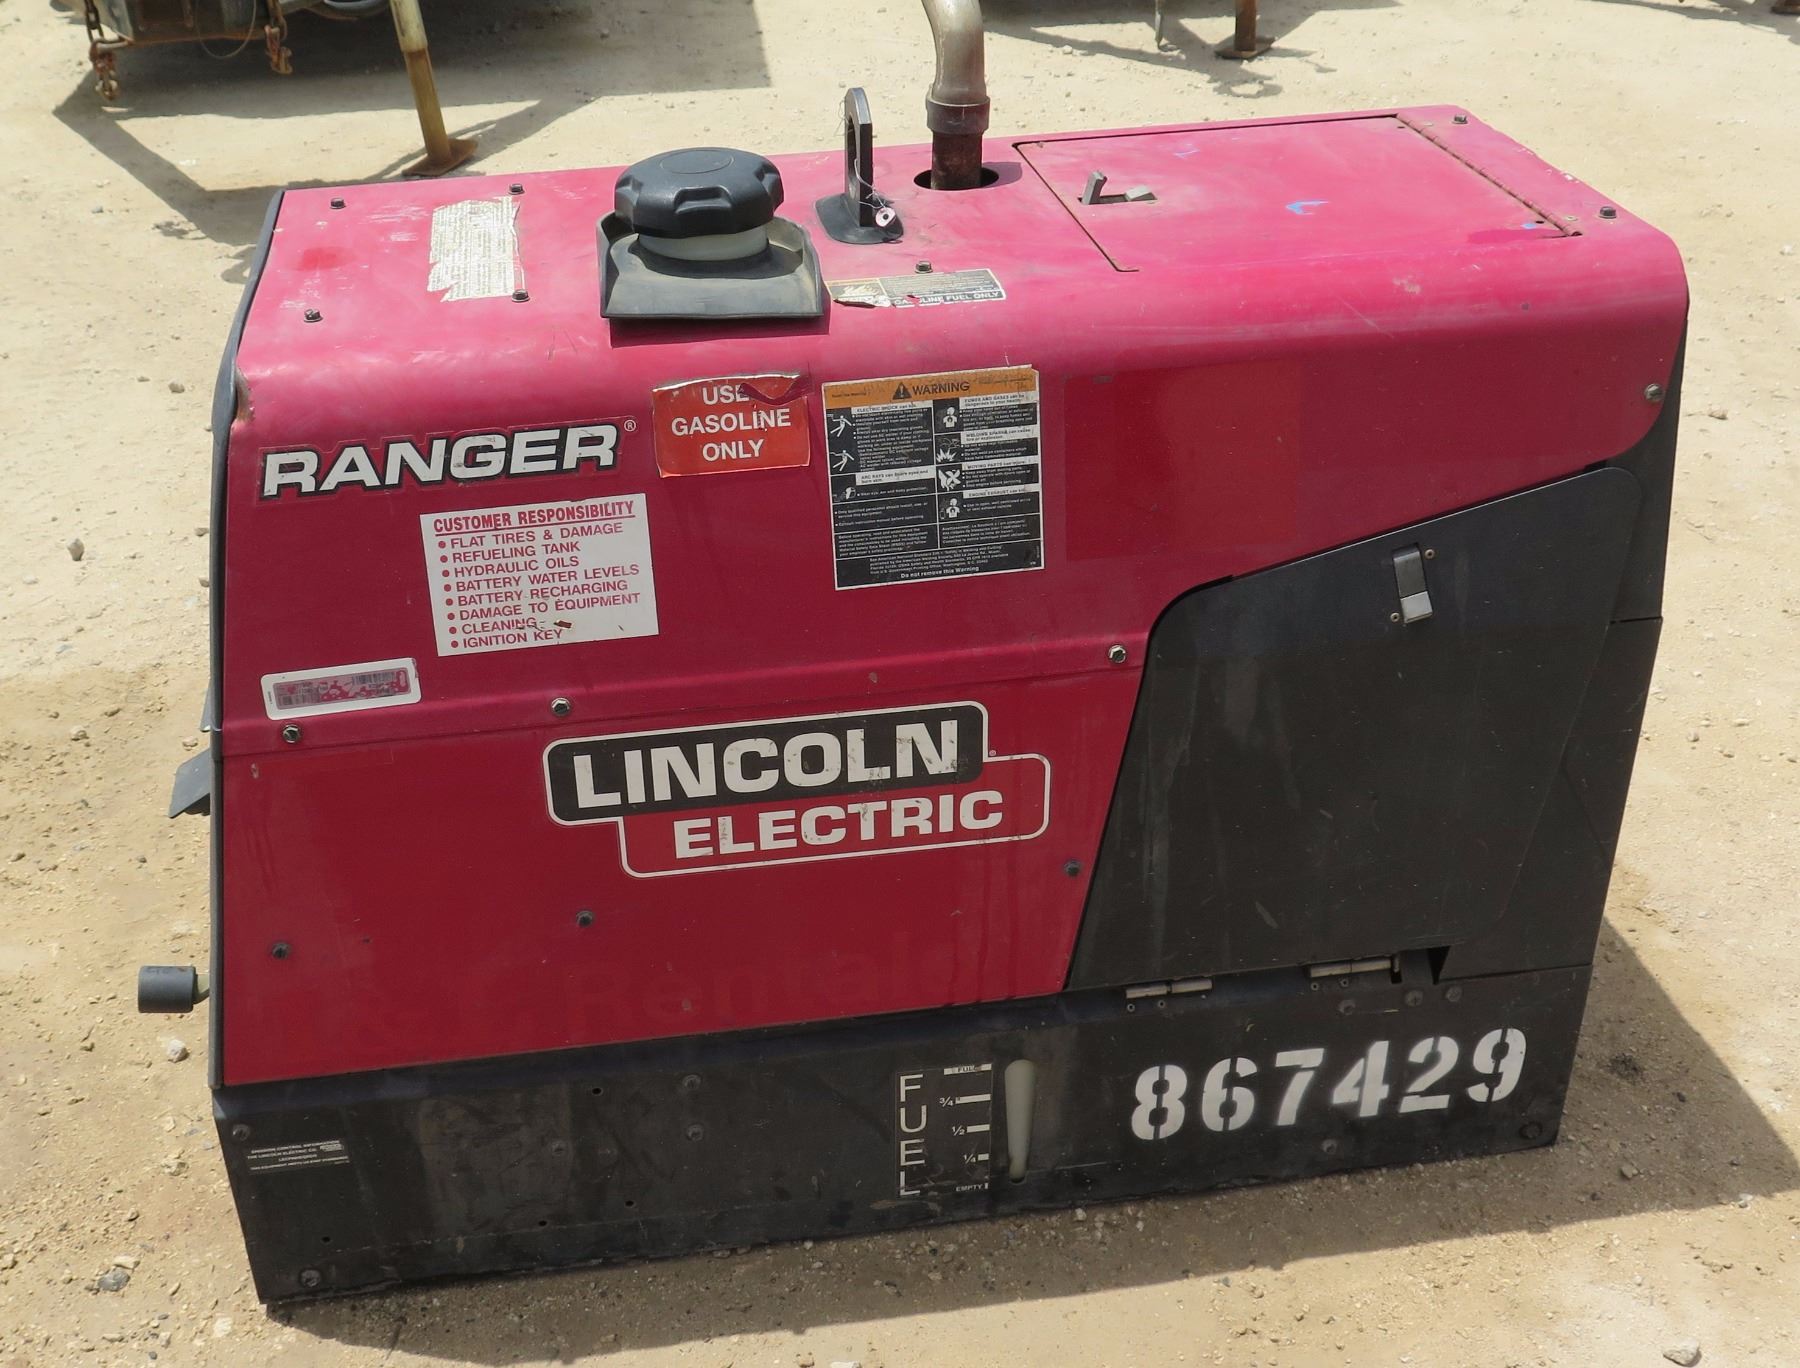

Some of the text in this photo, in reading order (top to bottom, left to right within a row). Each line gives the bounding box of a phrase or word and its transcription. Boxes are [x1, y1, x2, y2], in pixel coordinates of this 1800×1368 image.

[947, 293, 973, 301] FUEL
[973, 291, 999, 300] ONLY
[913, 382, 970, 395] WARNING
[671, 408, 792, 436] GASOLINE
[263, 424, 619, 498] RANGER
[702, 439, 764, 462] ONLY
[433, 500, 634, 532] CUSTOMER RESPONSIBILITY
[450, 522, 623, 548] FLAT TIRES & DAMAGE
[452, 541, 580, 563] REFUELING TANK
[454, 556, 579, 577] HYDRAULIC OILS
[455, 564, 639, 591] BATTERY WATER LEVELS
[955, 565, 978, 573] Warning
[457, 580, 627, 606] BATTERY RECHARGING
[459, 593, 640, 620] DAMAGE TO EQUIPMENT
[461, 617, 536, 634] CLEANING
[463, 629, 562, 648] IGNITION KEY
[573, 719, 959, 808] LINCOLN
[673, 790, 1003, 859] ELECTRIC
[1131, 1028, 1527, 1140] 867429
[900, 1074, 927, 1196] FUEL
[956, 1184, 983, 1192] EMPTY
